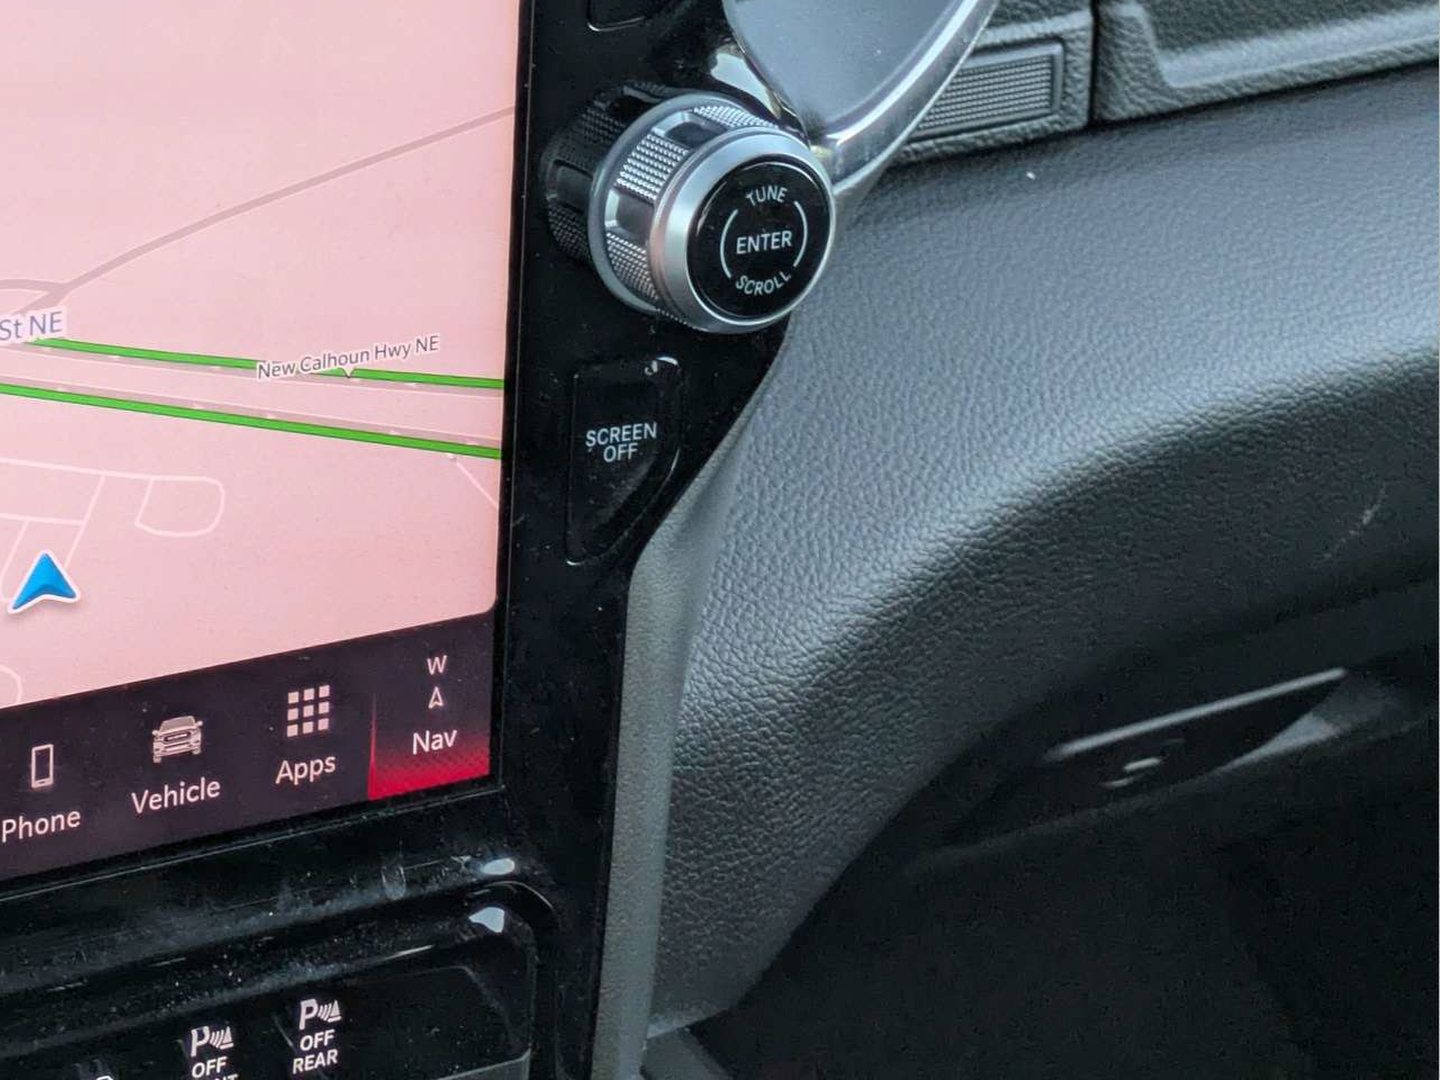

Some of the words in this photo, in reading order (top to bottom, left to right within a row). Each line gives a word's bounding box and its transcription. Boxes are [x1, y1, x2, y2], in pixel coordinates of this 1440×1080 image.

[745, 185, 789, 208] TUNE
[735, 230, 793, 255] ENTER
[735, 270, 792, 296] SCROLL
[28, 310, 64, 337] NE
[257, 359, 298, 380] New
[299, 348, 371, 374] Calhoun
[374, 339, 413, 361] Hwy
[415, 334, 440, 354] NE
[585, 422, 658, 448] SCREEN
[603, 443, 639, 464] OFF
[426, 654, 448, 676] W
[412, 728, 458, 755] Nav
[275, 753, 337, 787] Apps
[131, 776, 222, 815] Vehicle
[1, 807, 83, 845] Phone
[299, 1028, 336, 1052] OFF
[191, 1055, 229, 1079] OFF
[292, 1048, 339, 1074] REAR
